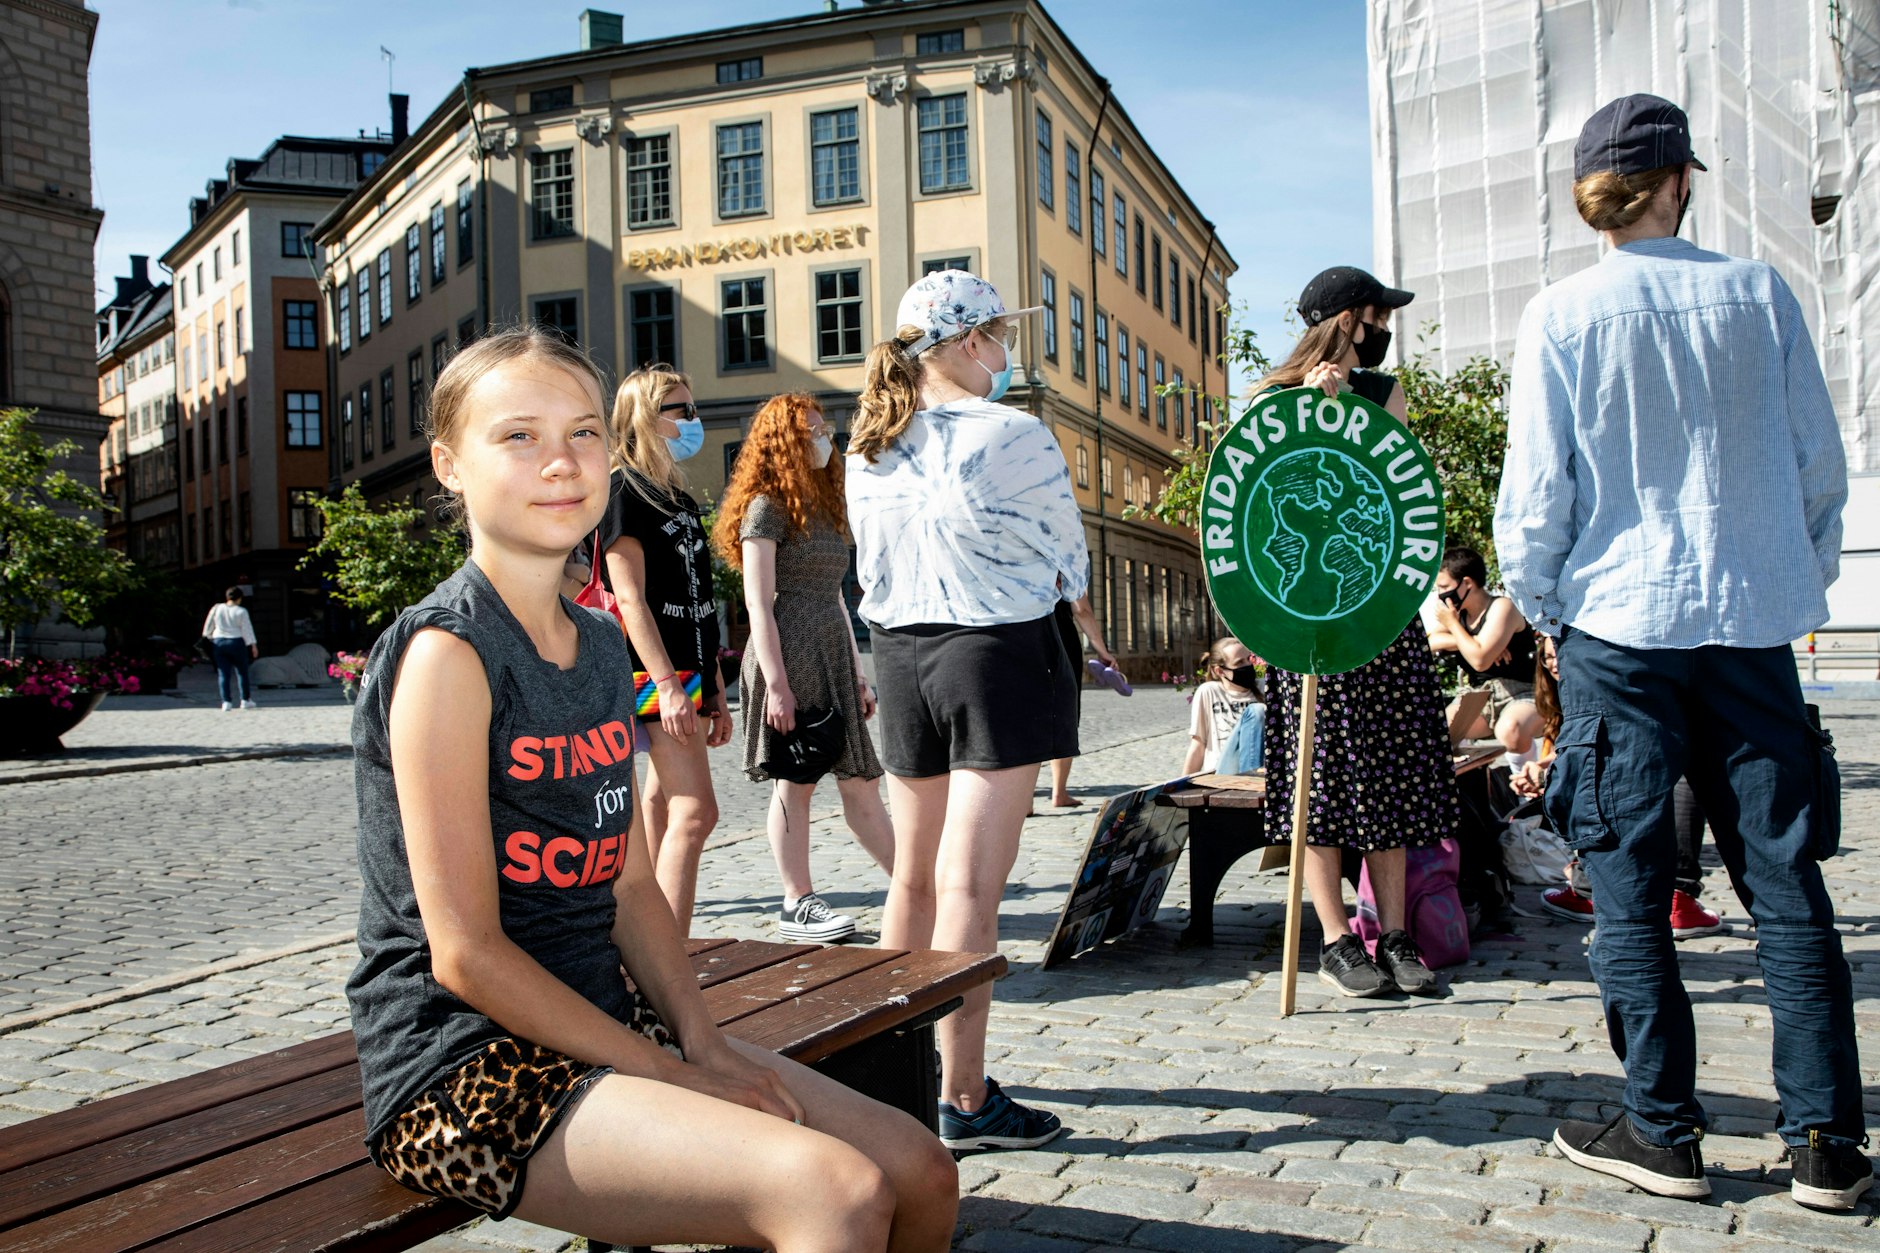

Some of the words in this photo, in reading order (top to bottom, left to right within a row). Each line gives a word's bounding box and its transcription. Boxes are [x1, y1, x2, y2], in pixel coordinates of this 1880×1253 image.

[628, 223, 866, 268] BRANDKONTORET
[1206, 404, 1287, 577] FRIDAYS
[1296, 394, 1370, 446] FOR
[1370, 429, 1439, 592] FUTURE
[662, 602, 684, 619] NOT
[690, 567, 698, 599] FOREVER
[695, 627, 703, 660] FOREVER
[507, 720, 631, 781] STAND
[594, 779, 628, 829] for
